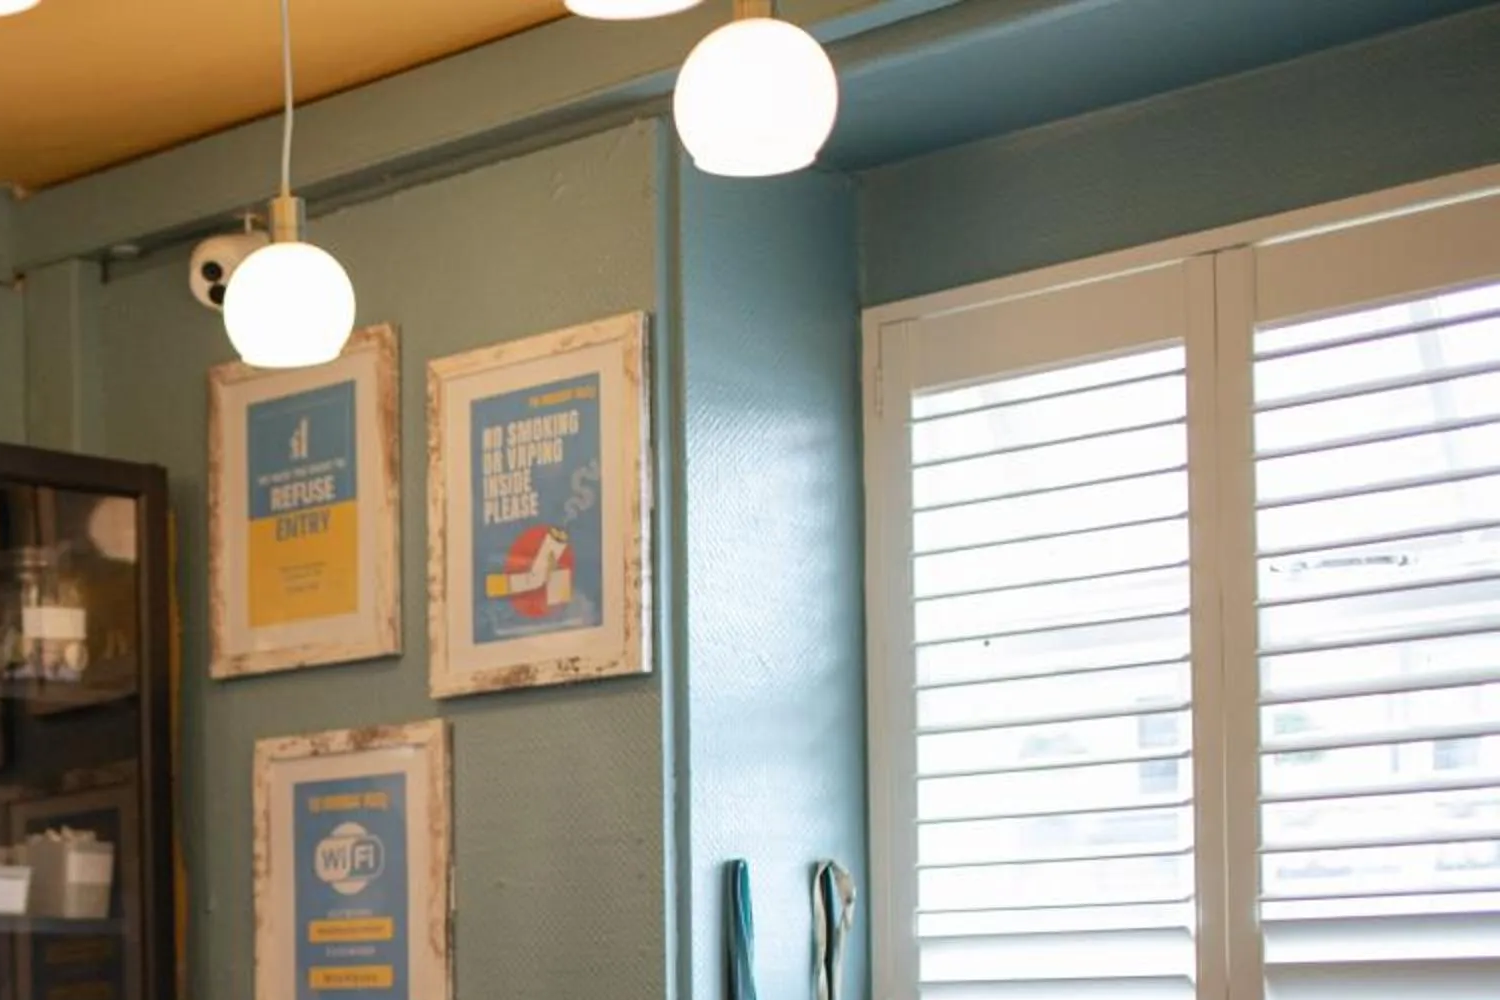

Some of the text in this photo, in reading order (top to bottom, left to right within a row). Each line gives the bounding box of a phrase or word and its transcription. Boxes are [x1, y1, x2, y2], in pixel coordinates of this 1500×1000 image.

[483, 409, 579, 450] NO SMOKING
[507, 437, 563, 470] VAPING
[270, 475, 336, 513] REFUSE
[483, 468, 532, 499] INSIDE
[276, 507, 332, 543] ENTRY
[483, 491, 539, 526] PLEASE
